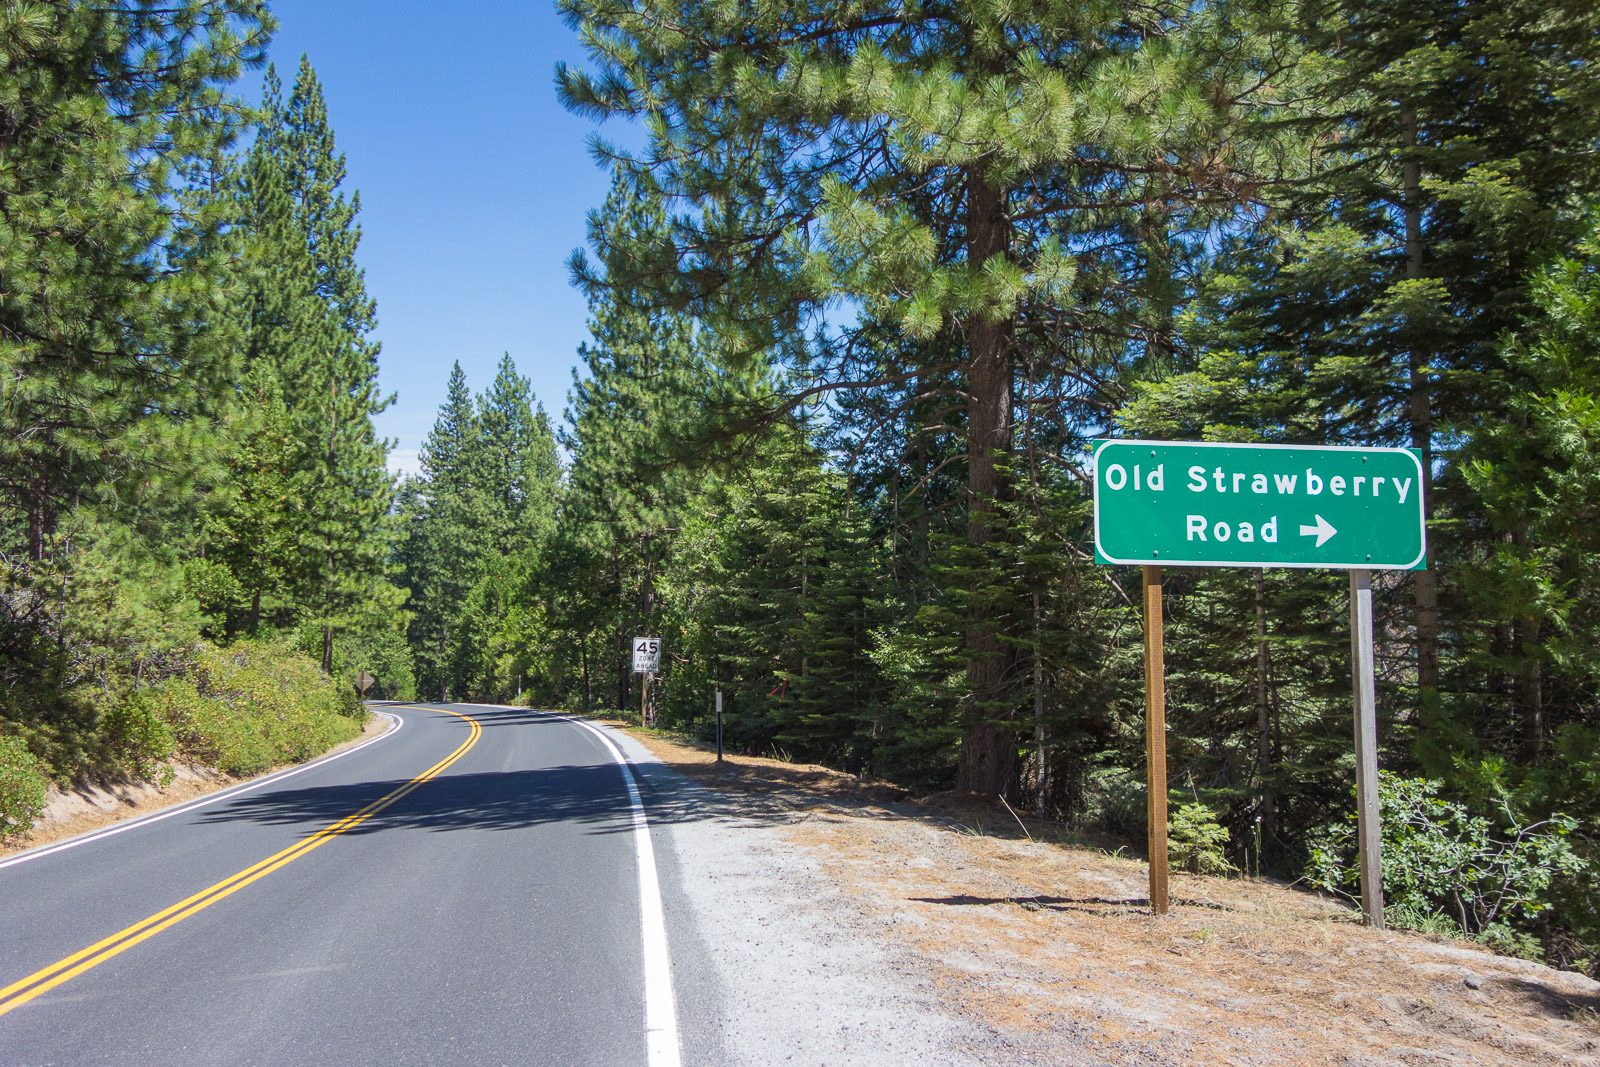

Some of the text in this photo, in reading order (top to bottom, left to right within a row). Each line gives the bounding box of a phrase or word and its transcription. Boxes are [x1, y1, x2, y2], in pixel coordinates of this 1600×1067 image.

[1105, 463, 1412, 503] Old Strawberry
[1186, 514, 1278, 543] Road
[636, 642, 658, 654] 45
